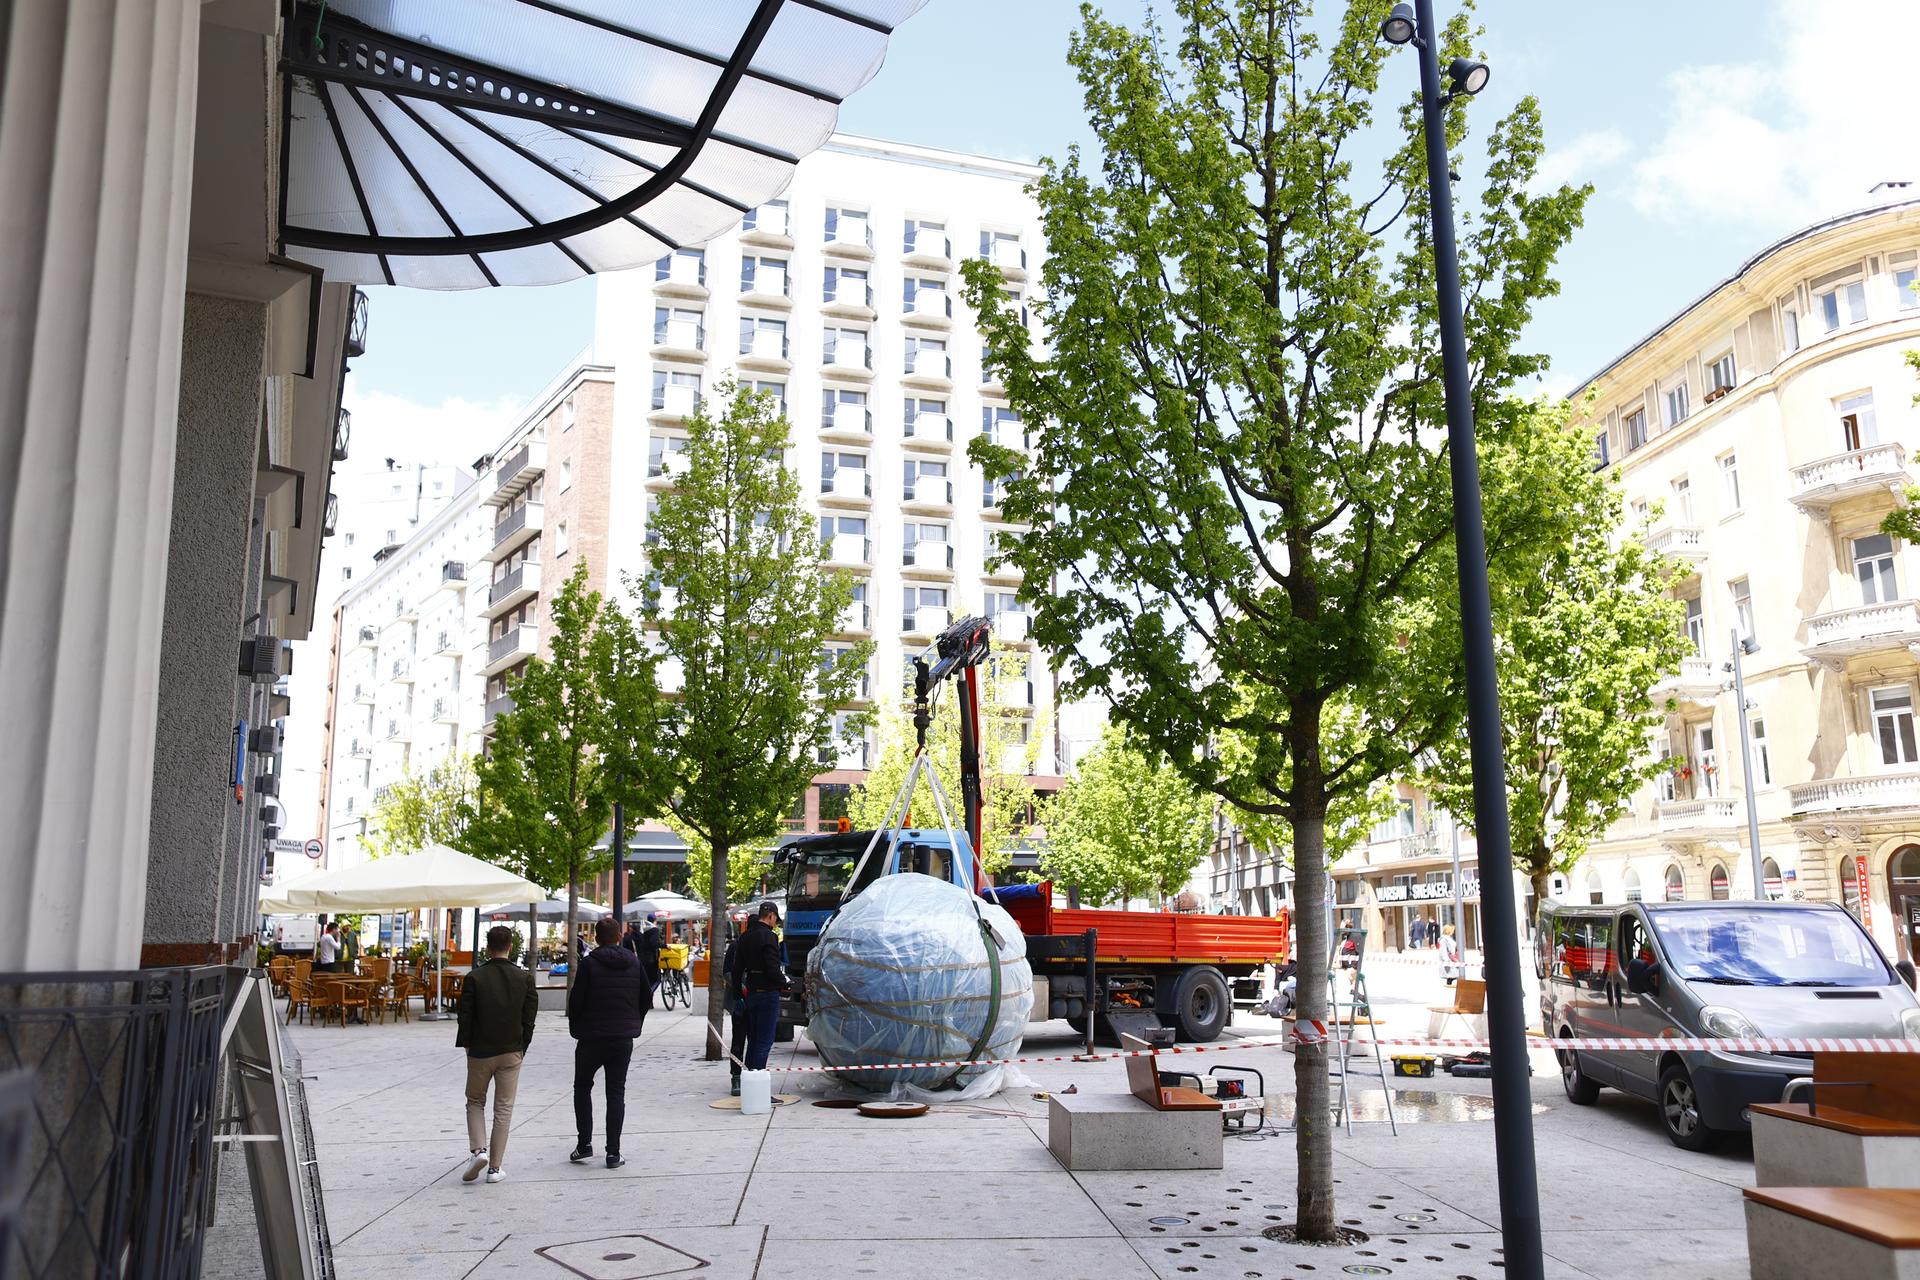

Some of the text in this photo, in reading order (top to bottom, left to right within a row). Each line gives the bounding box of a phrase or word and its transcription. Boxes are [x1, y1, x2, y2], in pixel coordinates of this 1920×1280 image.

[276, 839, 302, 847] UWAGA
[1376, 879, 1480, 901] WARSAW SNEAKER TORE
[1860, 874, 1870, 918] DEDALUS
